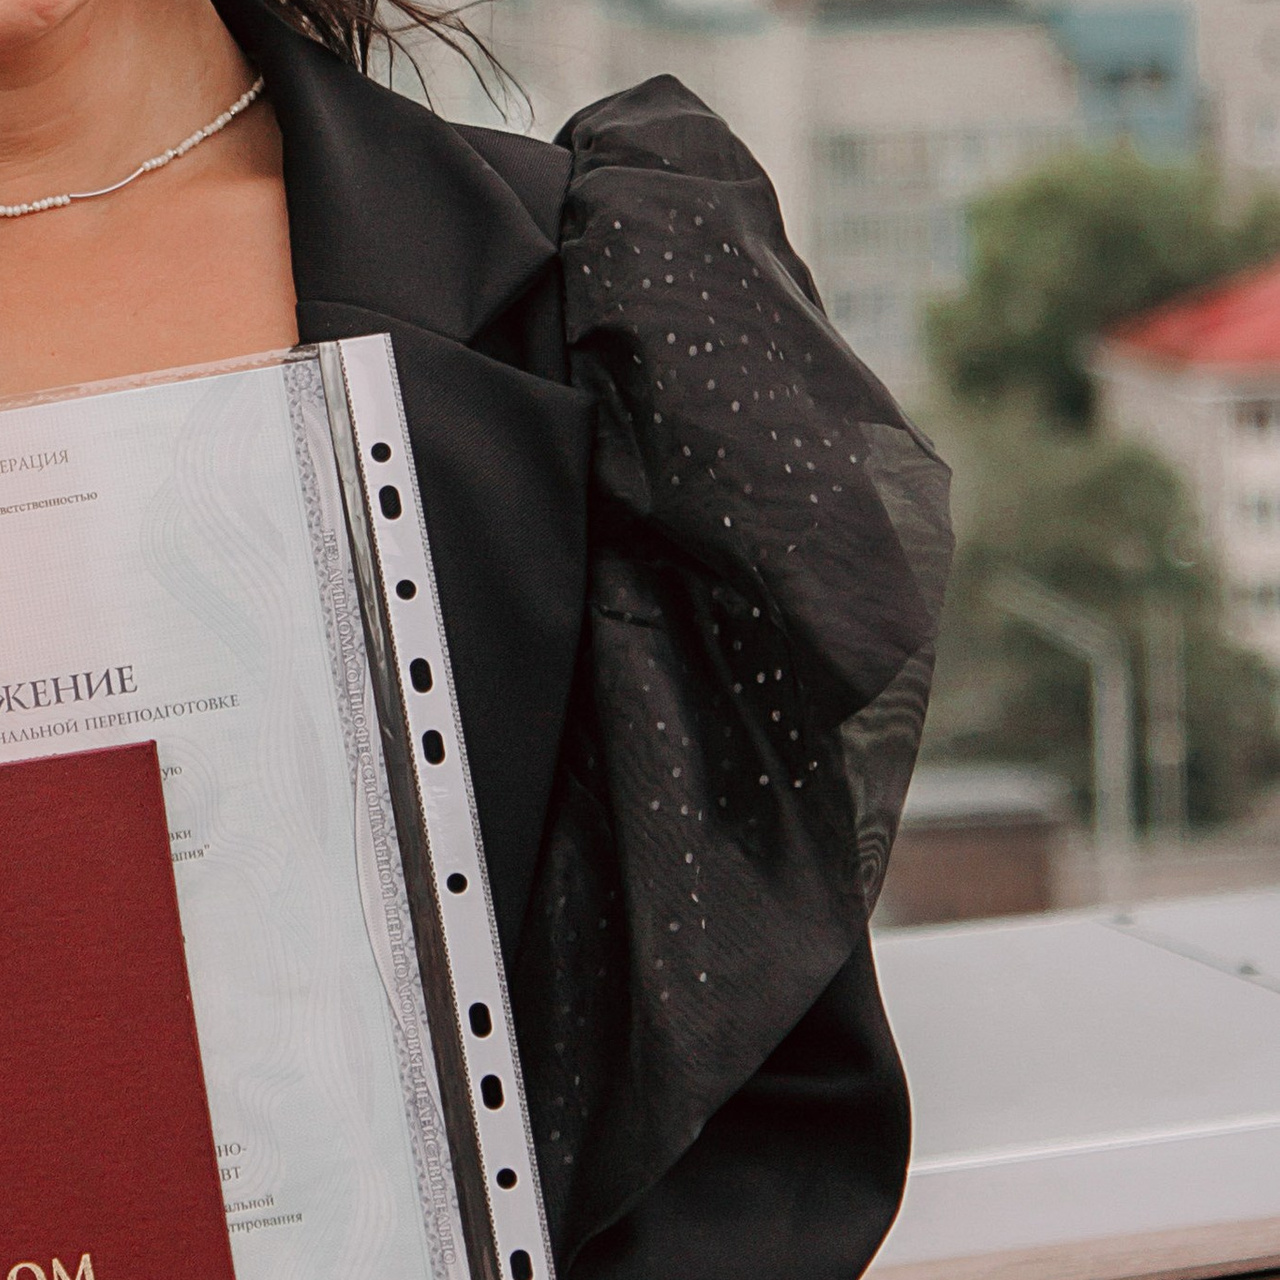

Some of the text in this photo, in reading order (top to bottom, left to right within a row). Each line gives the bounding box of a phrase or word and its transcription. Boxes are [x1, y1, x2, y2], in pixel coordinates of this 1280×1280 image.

[84, 694, 240, 731] ПЕРЕПОДГОТОВКЕ
[224, 1194, 274, 1213] альной
[226, 1213, 303, 1233] тирования
